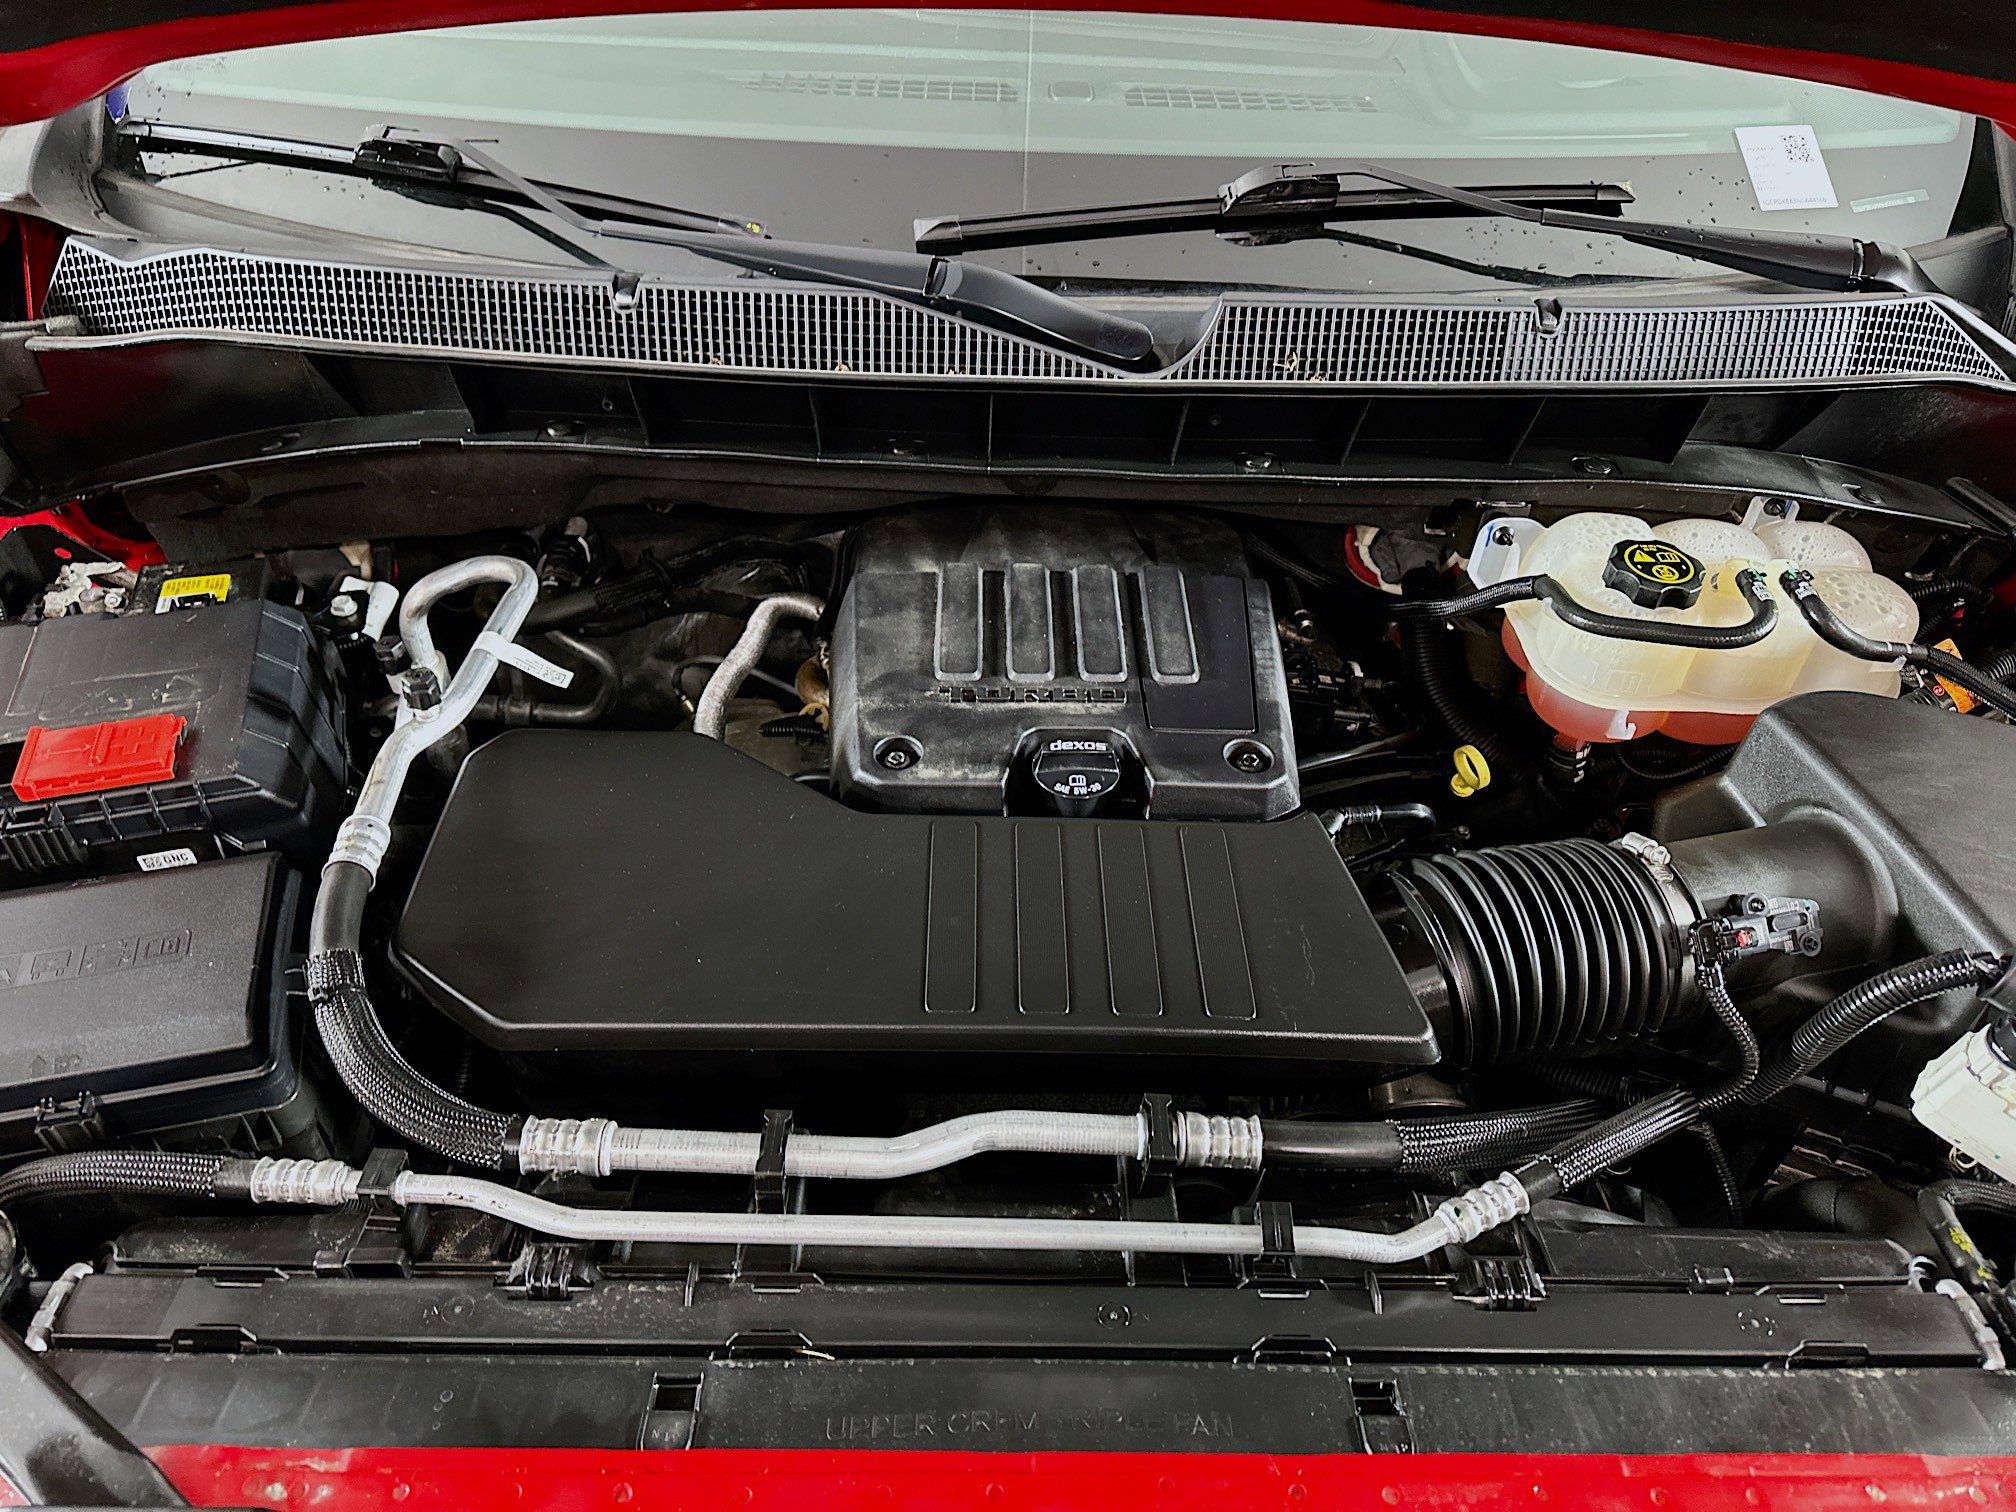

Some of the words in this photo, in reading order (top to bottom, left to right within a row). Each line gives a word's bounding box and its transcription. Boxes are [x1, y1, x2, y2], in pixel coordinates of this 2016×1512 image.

[937, 685, 1127, 704] TURBO
[1050, 739, 1108, 751] dexos
[1054, 783, 1070, 794] SAE
[1073, 782, 1101, 795] 5W-30
[826, 1412, 936, 1440] UPPER
